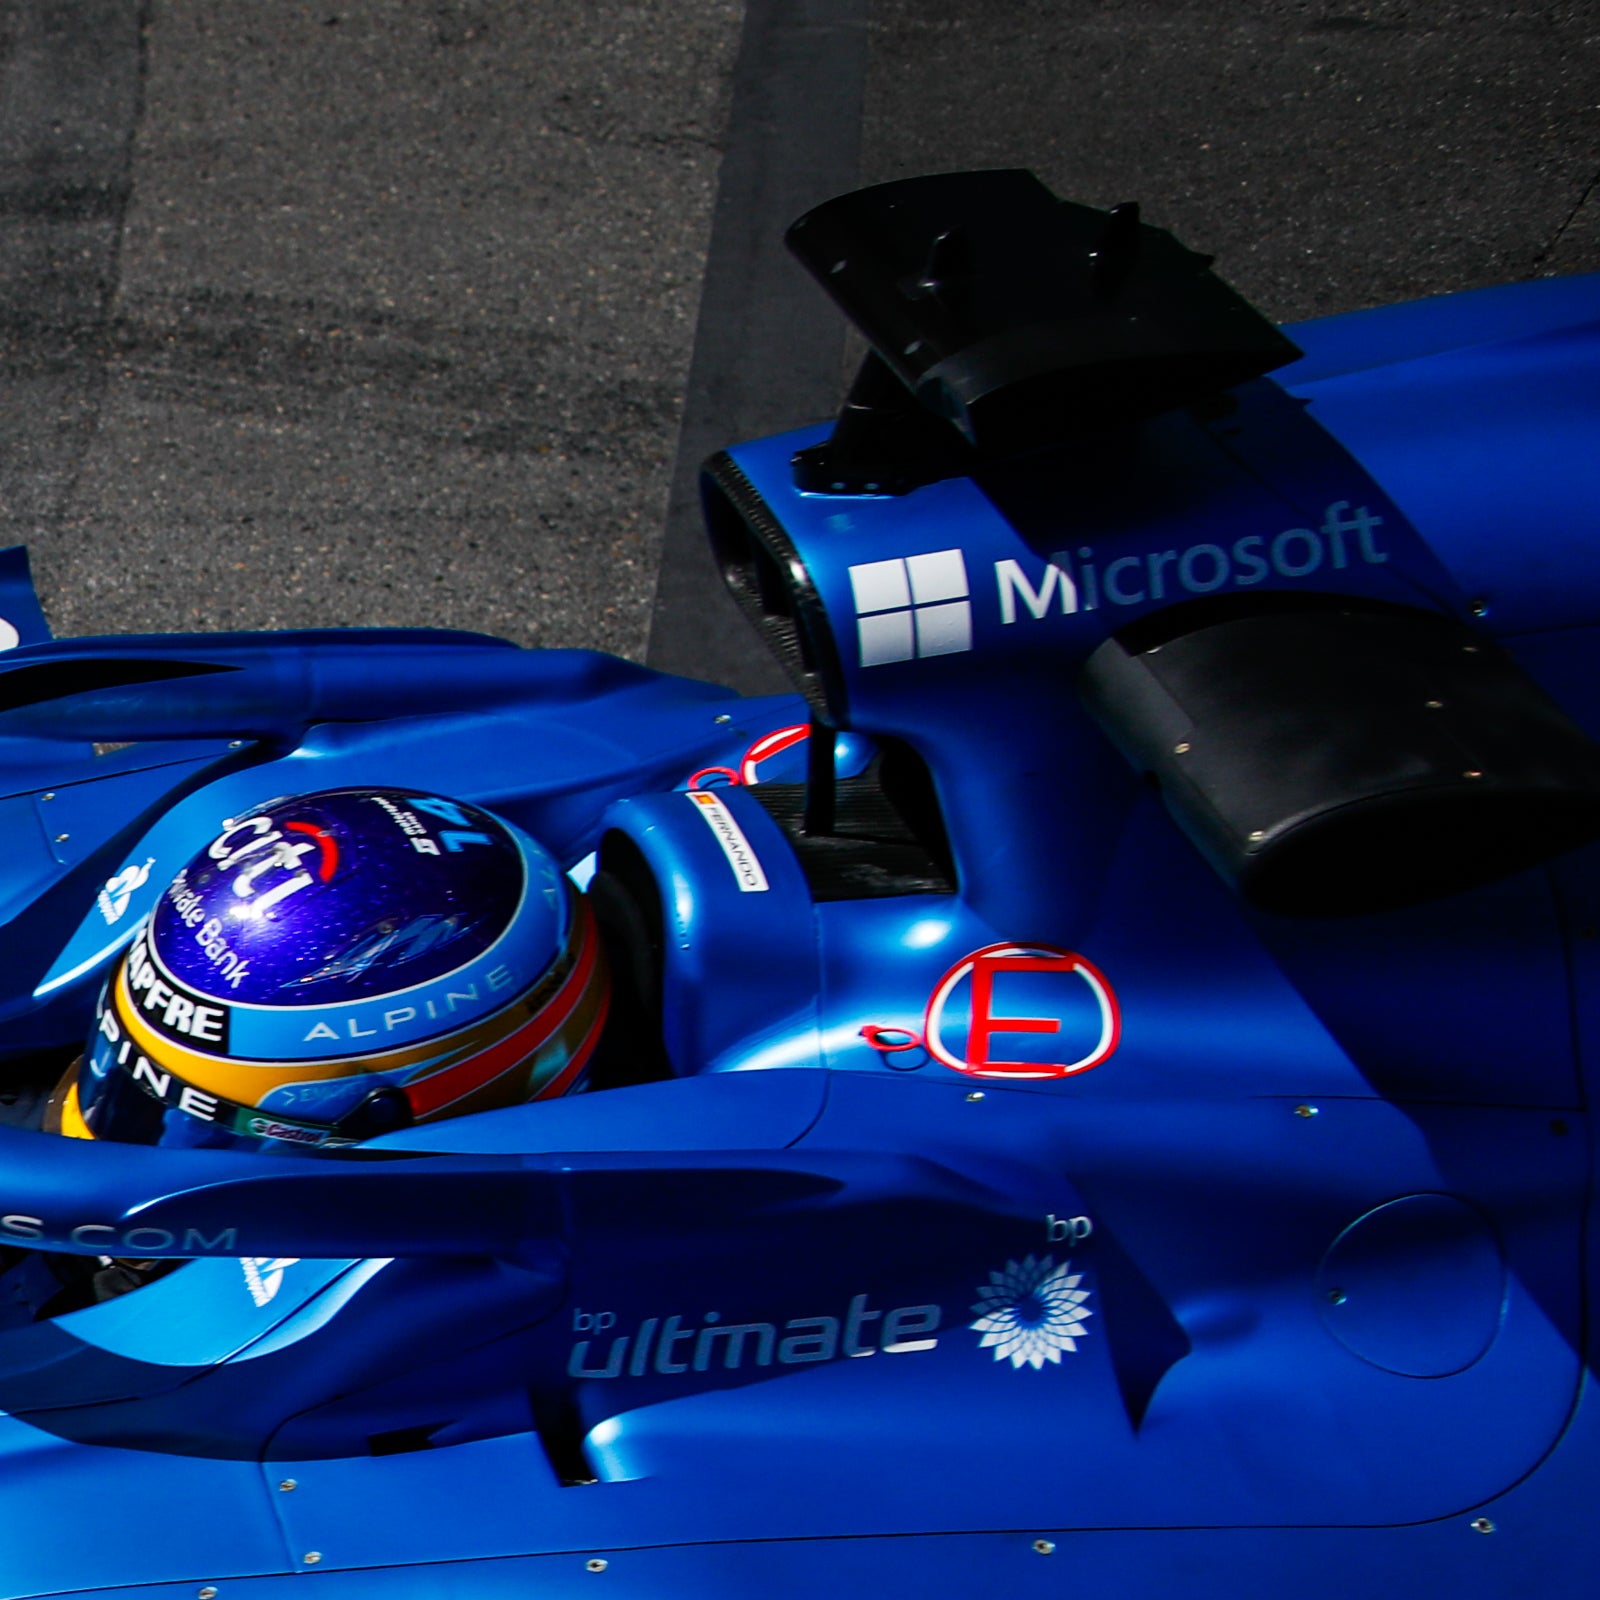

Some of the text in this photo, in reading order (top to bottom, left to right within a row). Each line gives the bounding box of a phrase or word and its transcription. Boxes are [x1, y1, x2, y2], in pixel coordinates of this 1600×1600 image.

[995, 500, 1389, 625] Microsoft
[708, 804, 760, 887] FERNANDO
[195, 917, 251, 990] Bank
[303, 963, 514, 1042] ALPINE
[1046, 1213, 1093, 1246] bp
[567, 1294, 941, 1379] ultimate
[572, 1306, 616, 1336] bp
